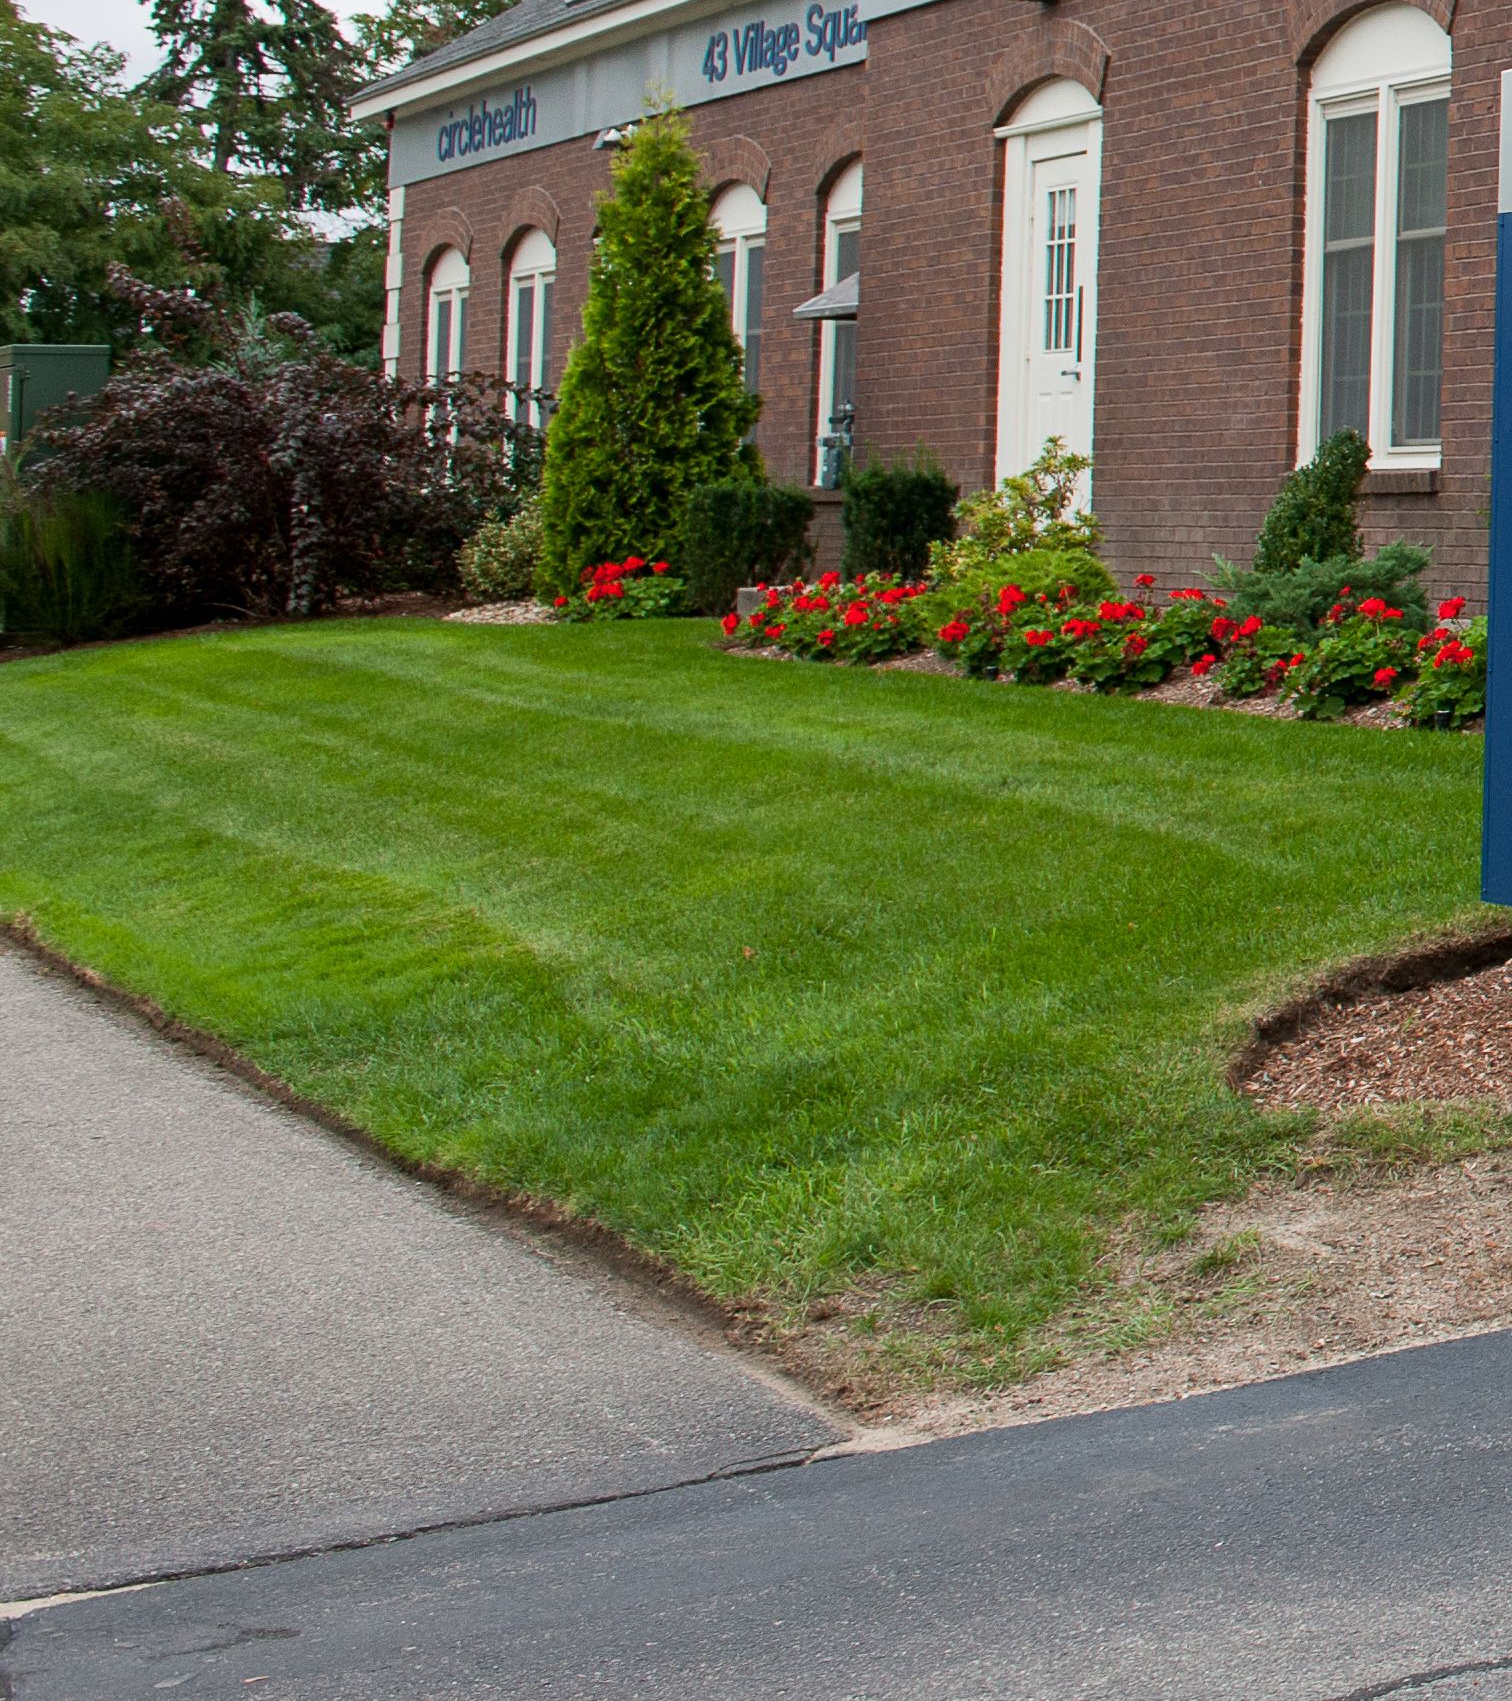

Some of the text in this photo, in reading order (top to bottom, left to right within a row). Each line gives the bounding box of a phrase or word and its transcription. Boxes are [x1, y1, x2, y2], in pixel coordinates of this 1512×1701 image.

[703, 31, 728, 83] 43
[732, 20, 800, 76] Village
[437, 85, 537, 163] circlehealth
